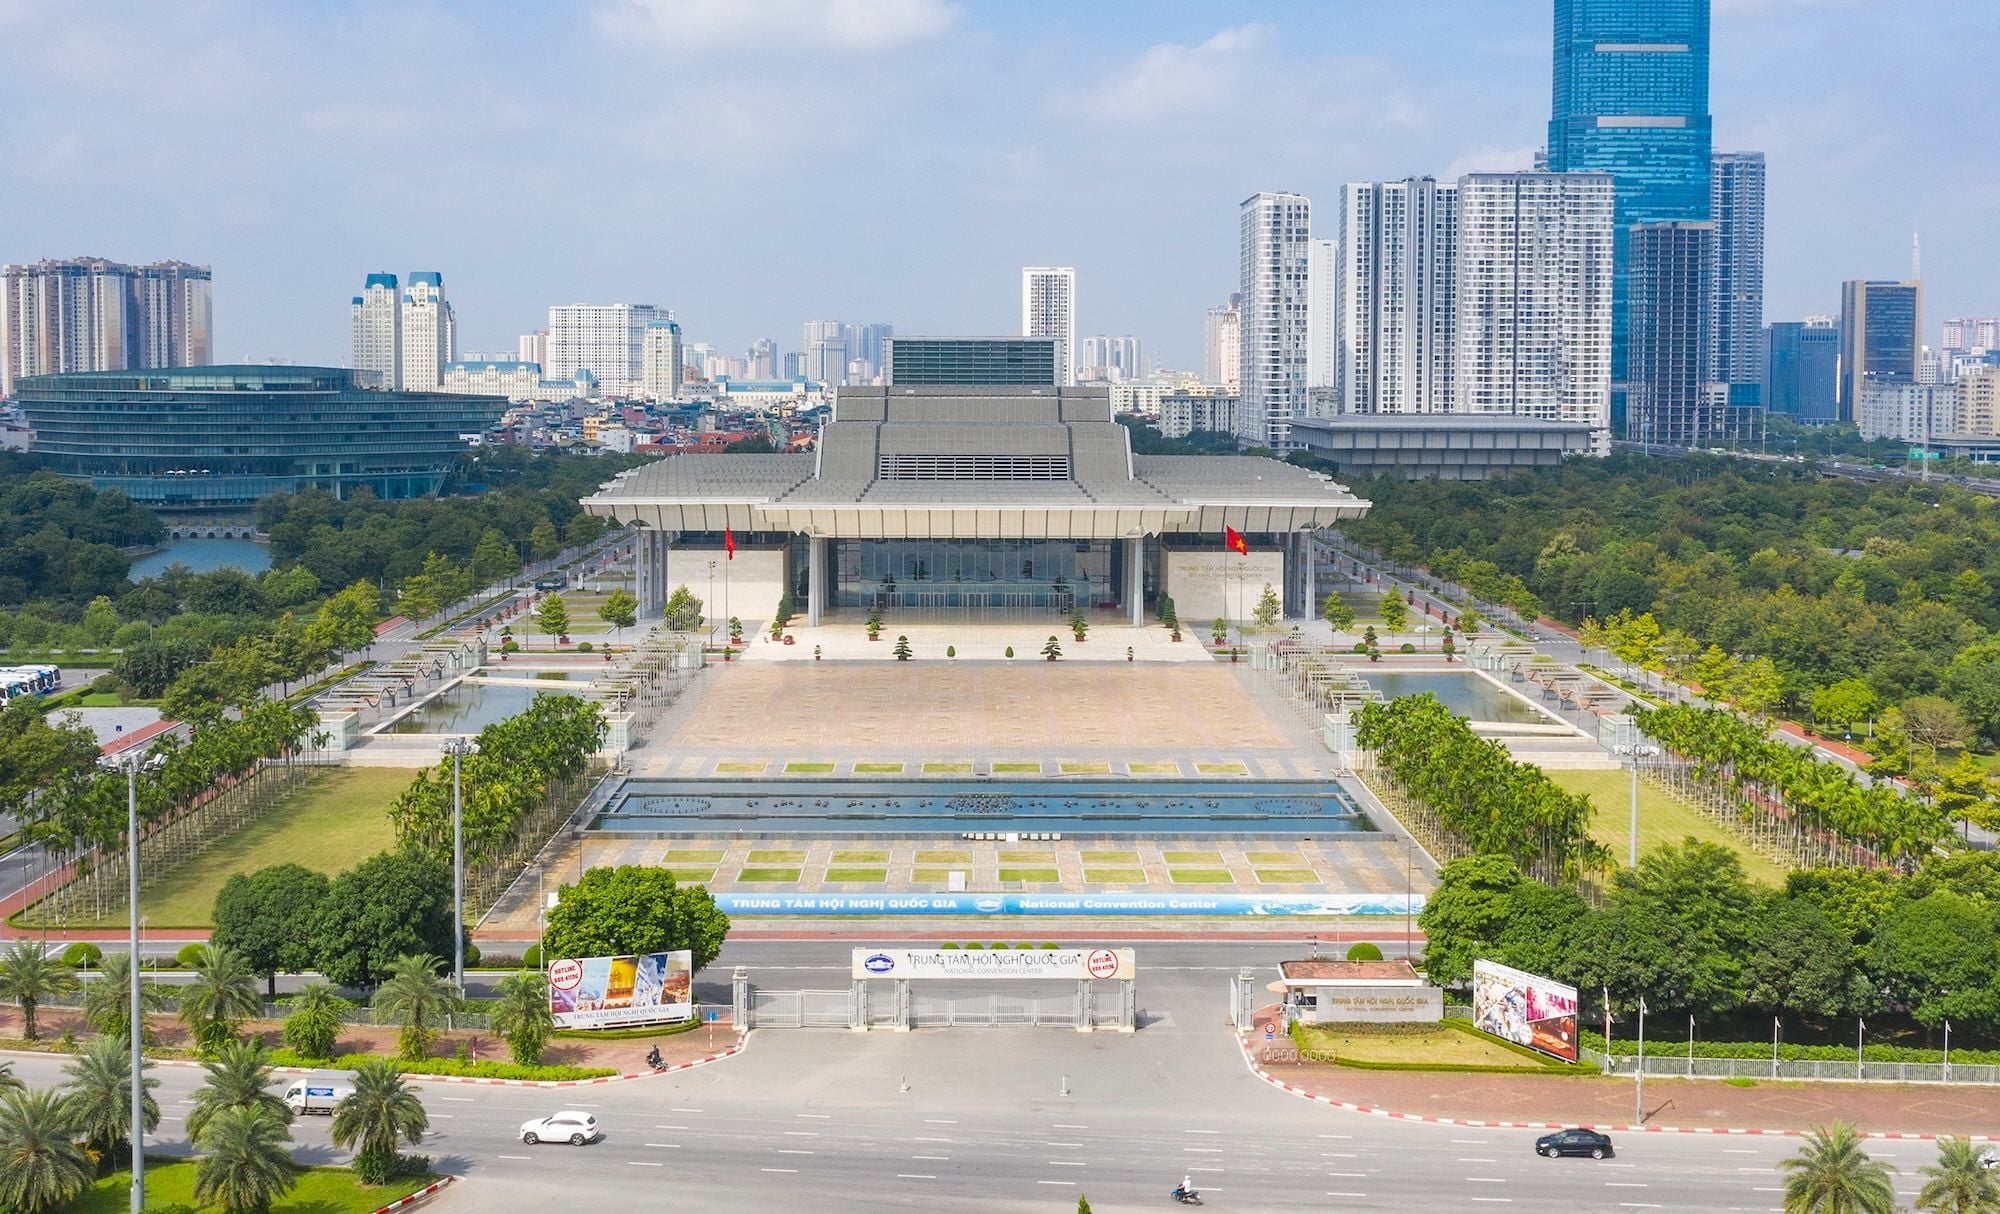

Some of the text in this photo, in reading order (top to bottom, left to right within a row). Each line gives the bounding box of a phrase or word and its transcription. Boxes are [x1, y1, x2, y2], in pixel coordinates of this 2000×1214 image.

[732, 896, 958, 911] TRUNG TÂM HỘI NGHỊ QUỐC GIA
[1019, 898, 1218, 909] National Convention Center
[908, 955, 944, 965] TRUNG
[947, 954, 970, 965] TÂM
[972, 954, 992, 966] HỘI
[1024, 954, 1058, 966] QUỐC
[1060, 955, 1078, 965] GIA
[555, 966, 575, 974] HOTLINE
[1353, 996, 1365, 1004] TÂM
[1396, 996, 1414, 1005] QUỐC
[610, 1010, 622, 1018] HỘI
[640, 1006, 657, 1014] QUỐC
